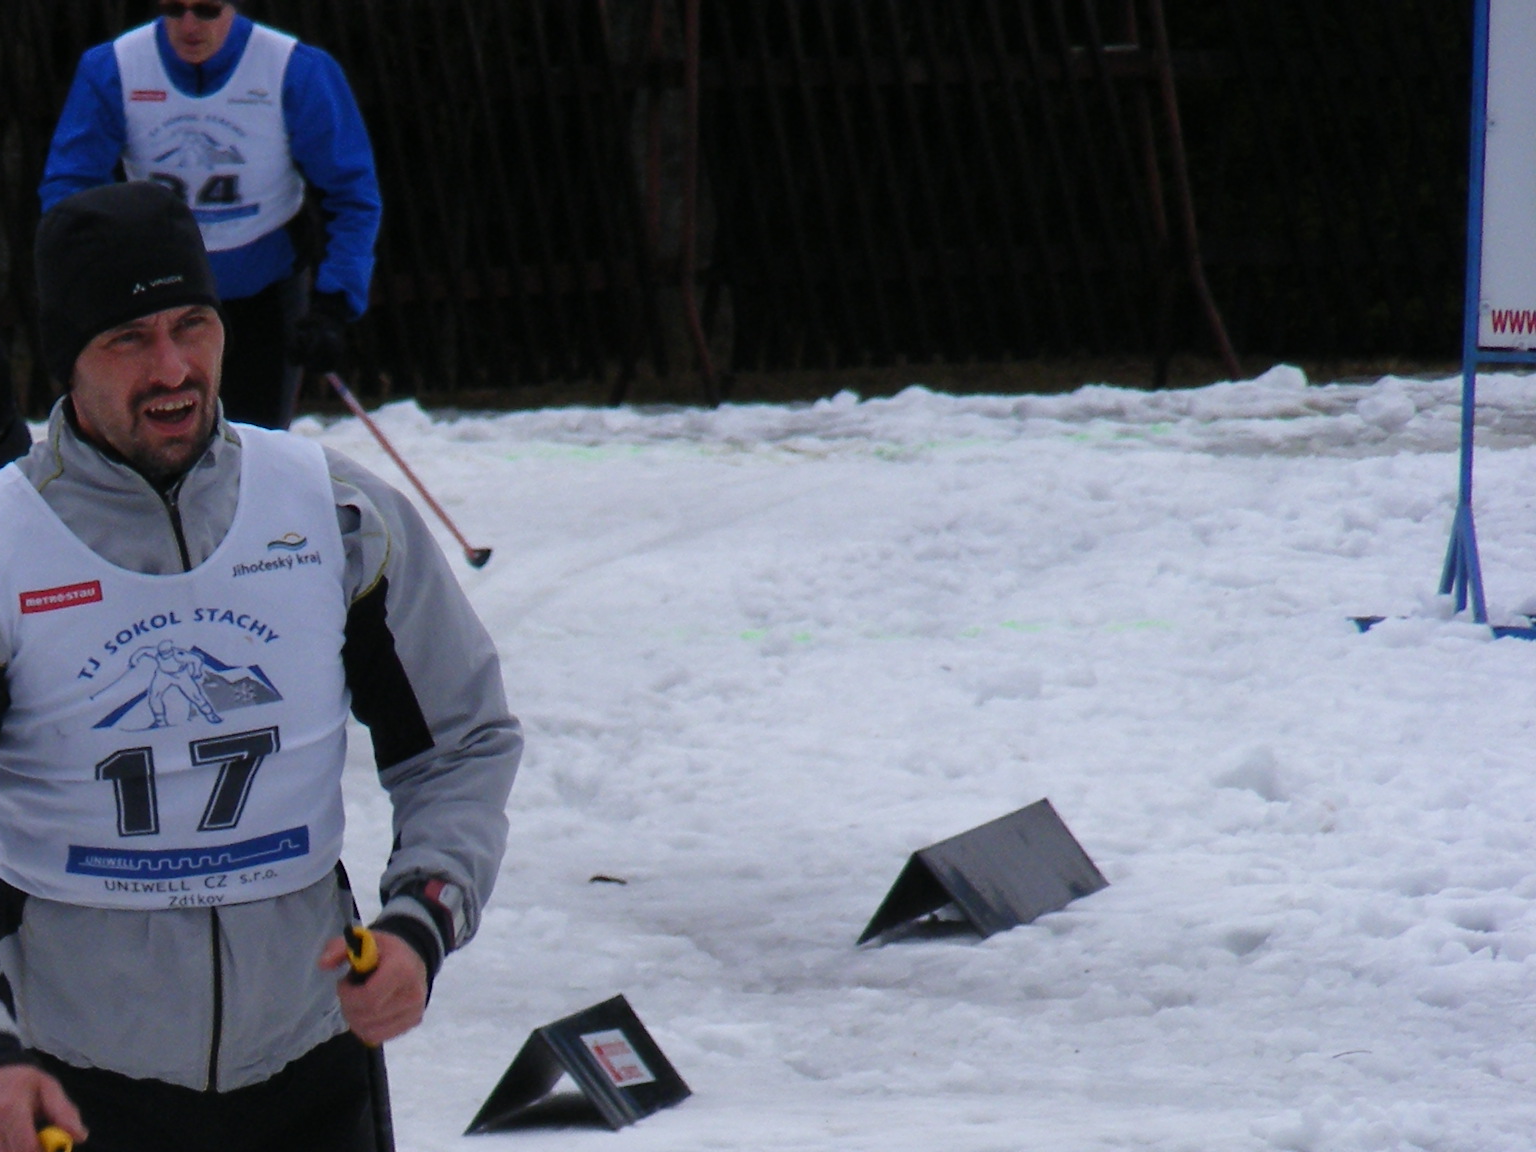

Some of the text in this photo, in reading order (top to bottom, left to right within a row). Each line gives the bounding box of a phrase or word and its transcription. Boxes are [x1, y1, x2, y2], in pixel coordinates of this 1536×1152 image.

[232, 550, 322, 577] Jihočeský kraj
[77, 607, 279, 680] TJ SOKOL STACHY
[95, 725, 282, 838] 17
[84, 854, 135, 869] UNIWELL
[104, 868, 278, 894] UNIWELL CZ s.r.o.
